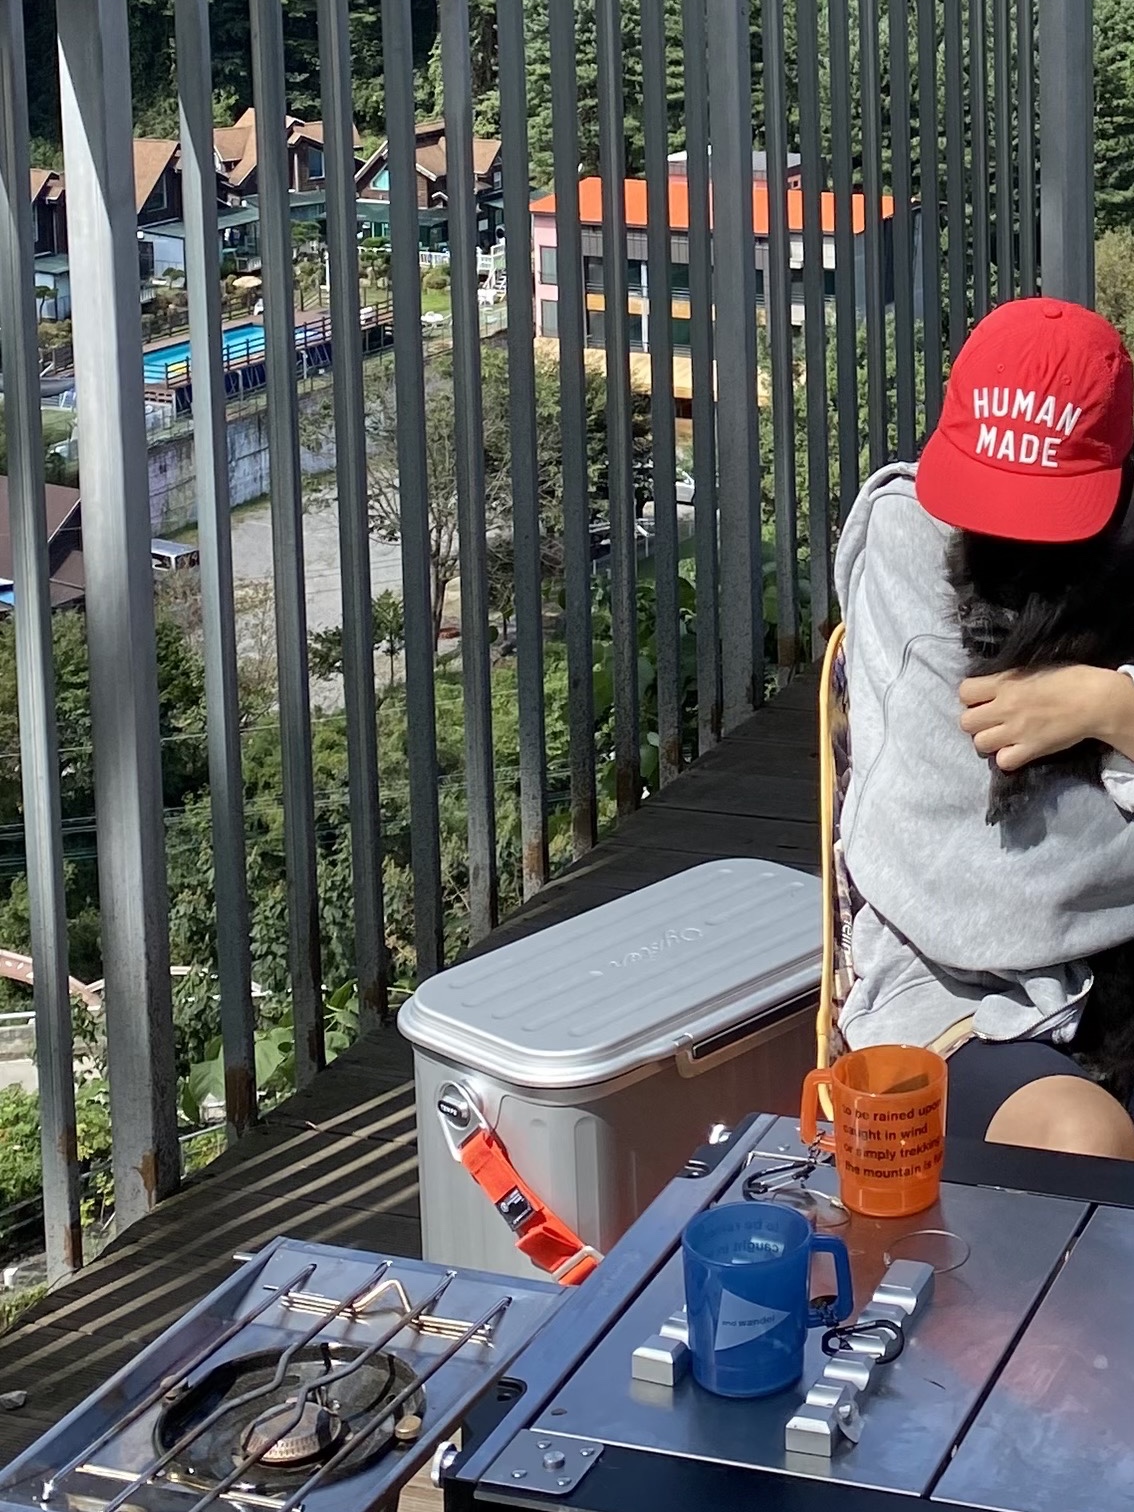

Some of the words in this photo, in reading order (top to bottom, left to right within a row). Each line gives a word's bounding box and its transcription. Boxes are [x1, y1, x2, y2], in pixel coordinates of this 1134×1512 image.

[973, 387, 1082, 436] HUMAN
[975, 424, 1062, 468] MADE
[873, 1108, 915, 1122] rained
[885, 1131, 896, 1140] in
[901, 1123, 928, 1139] wind
[845, 1160, 860, 1175] the
[864, 1165, 921, 1178] mountain
